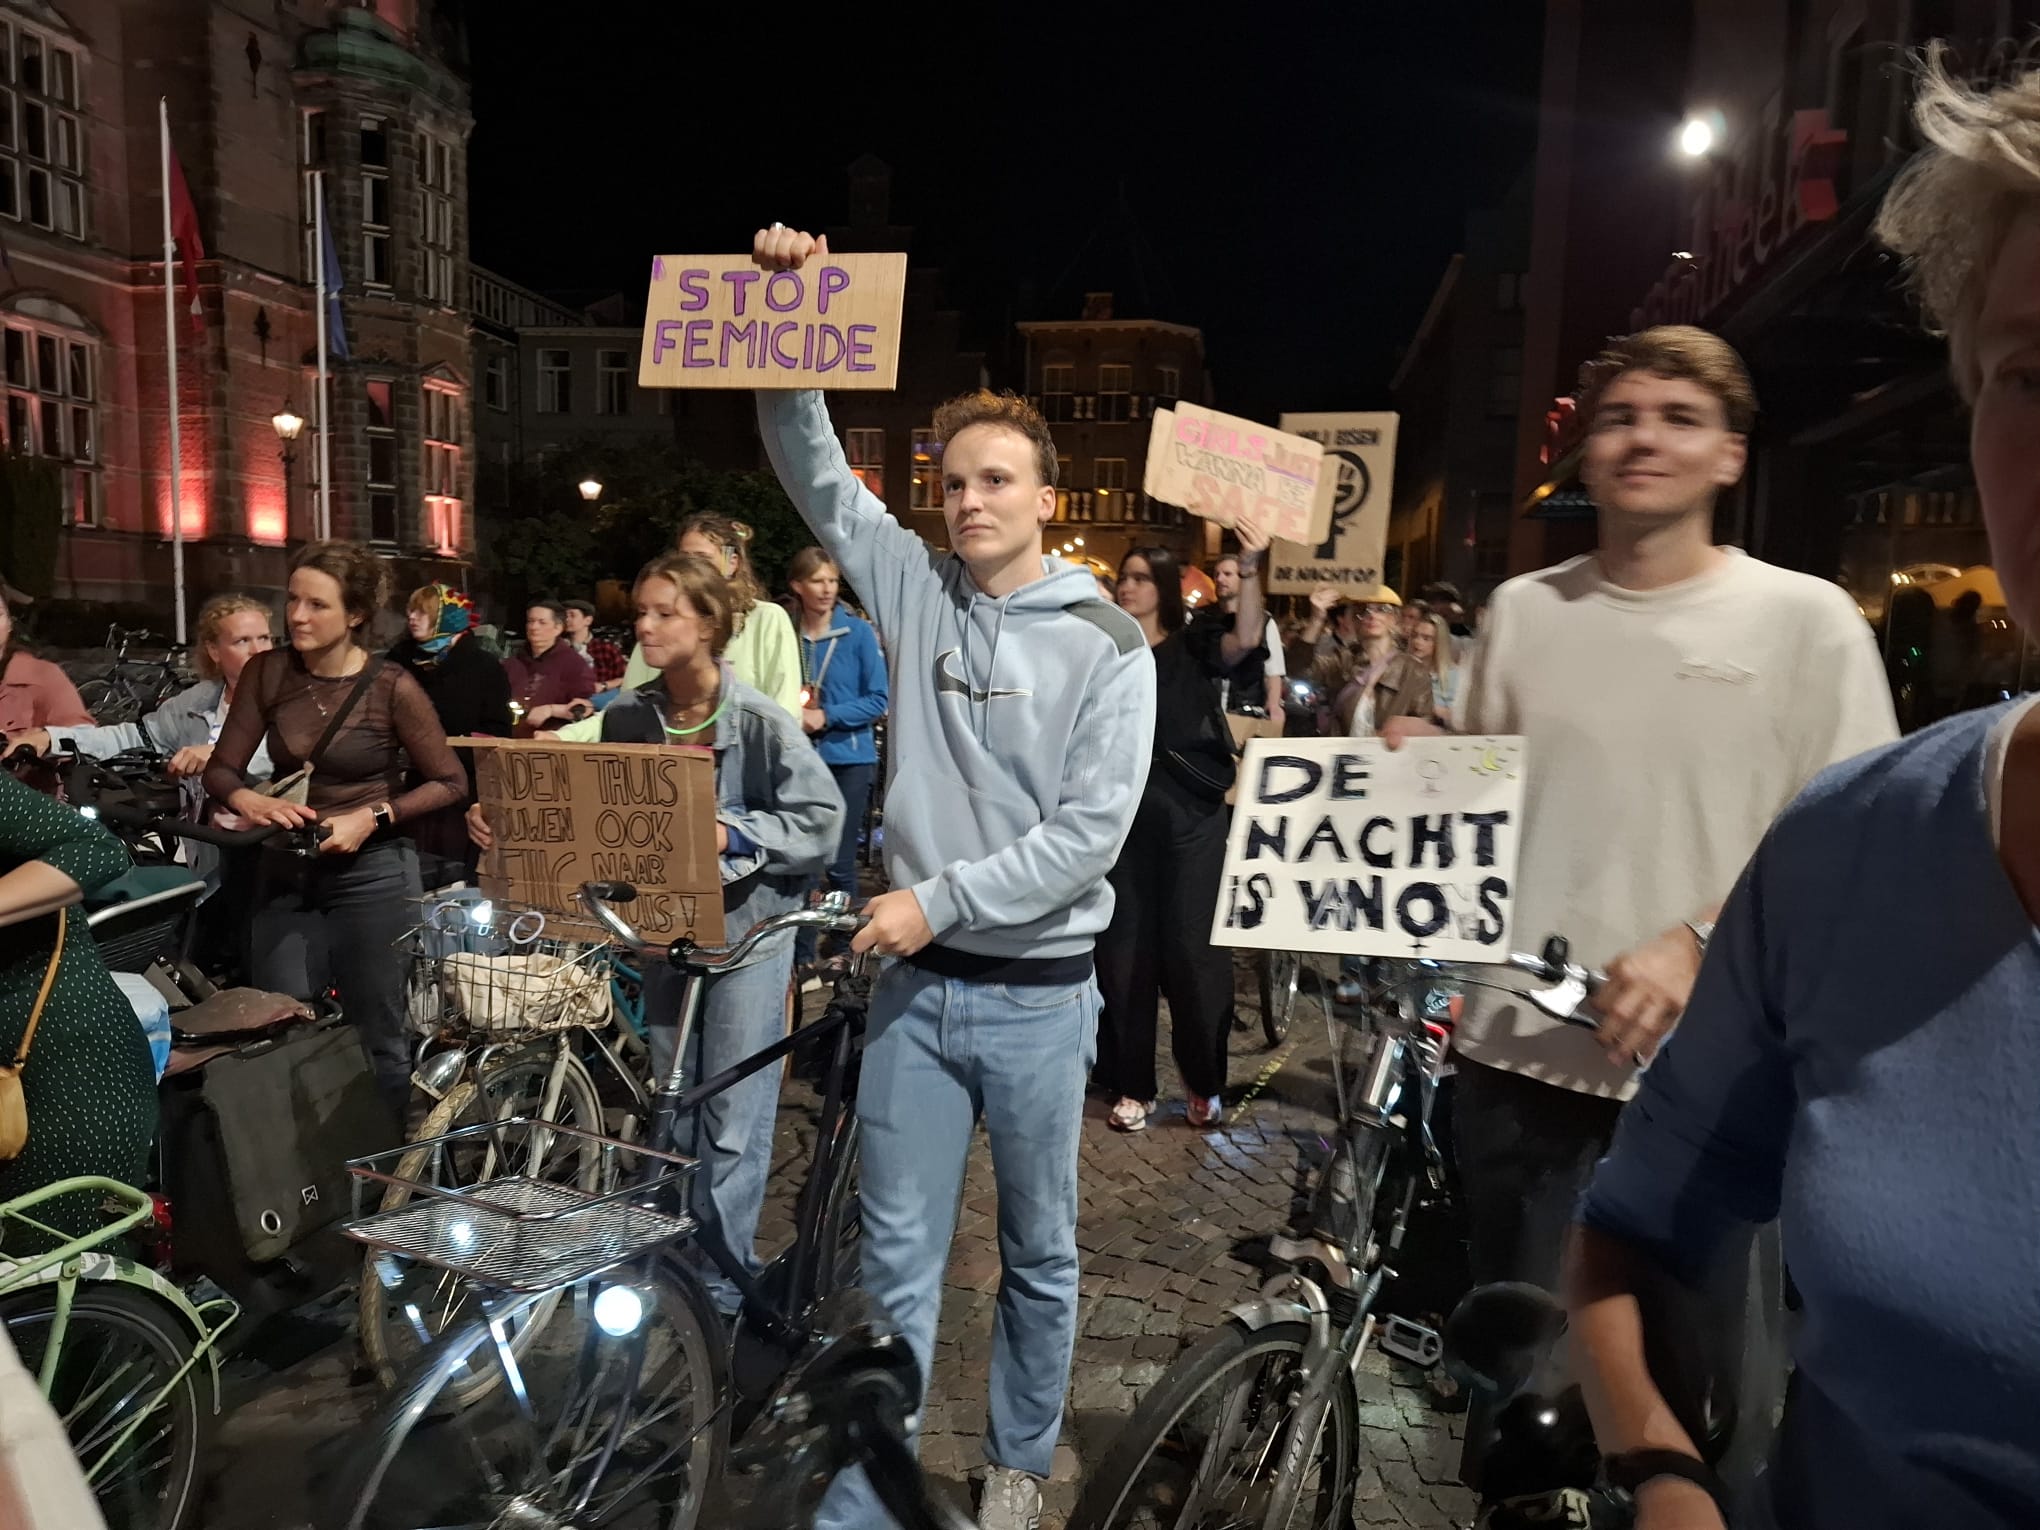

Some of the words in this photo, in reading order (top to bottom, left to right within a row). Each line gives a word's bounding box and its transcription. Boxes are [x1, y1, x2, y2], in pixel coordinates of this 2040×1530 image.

[680, 266, 850, 316] STOP
[653, 319, 877, 373] FEMICIDE
[1175, 416, 1267, 463] GIRLS
[1175, 442, 1266, 496] WANNA
[1186, 474, 1308, 545] SAFE
[584, 753, 678, 807] THUIS
[1256, 754, 1372, 804] DE
[596, 809, 673, 851] OOK
[1244, 810, 1510, 868] NACHT
[592, 852, 666, 884] NAAR
[1225, 873, 1274, 929] IS
